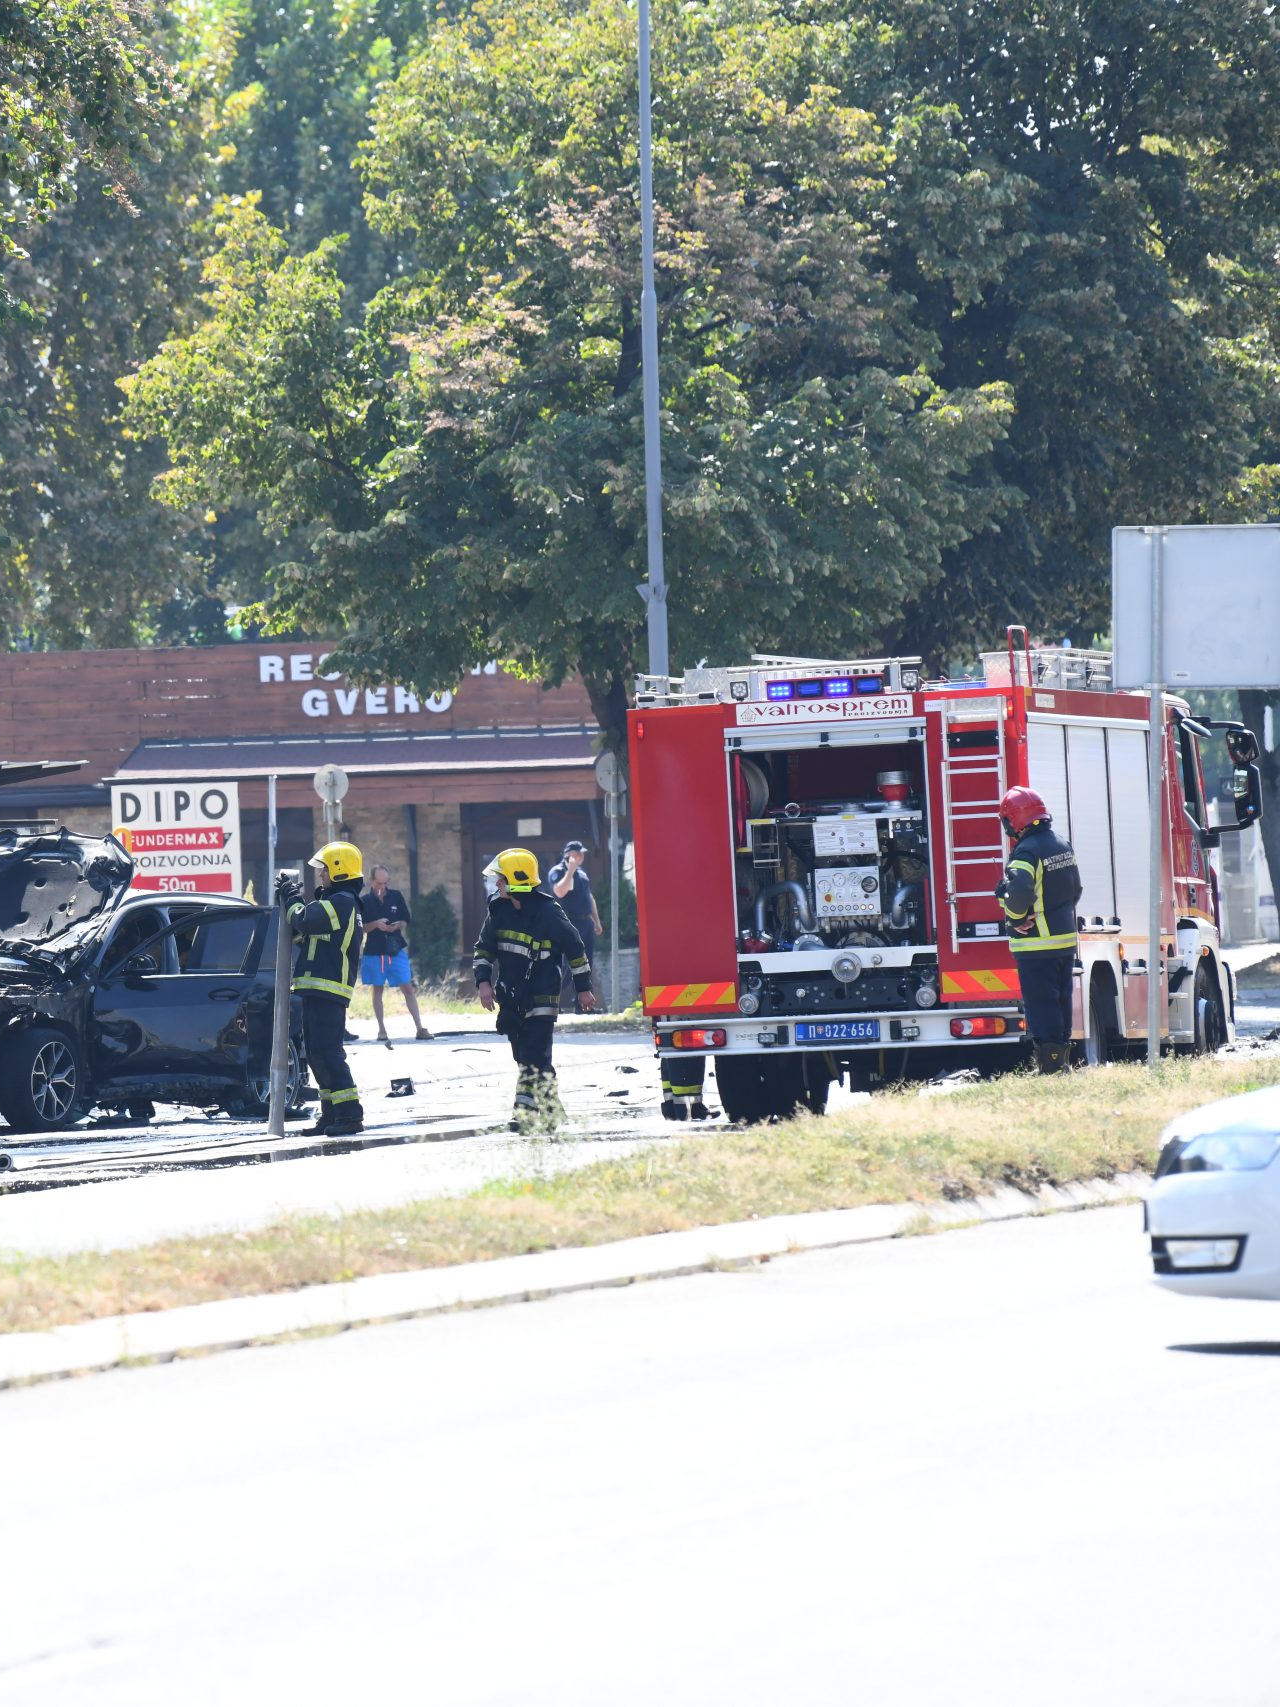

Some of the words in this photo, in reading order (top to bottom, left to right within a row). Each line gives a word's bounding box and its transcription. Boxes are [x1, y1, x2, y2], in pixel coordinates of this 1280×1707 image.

[301, 687, 454, 717] GVERO
[120, 789, 229, 823] DIPO
[133, 854, 232, 869] ROIZVODNJA
[158, 877, 197, 892] 50m
